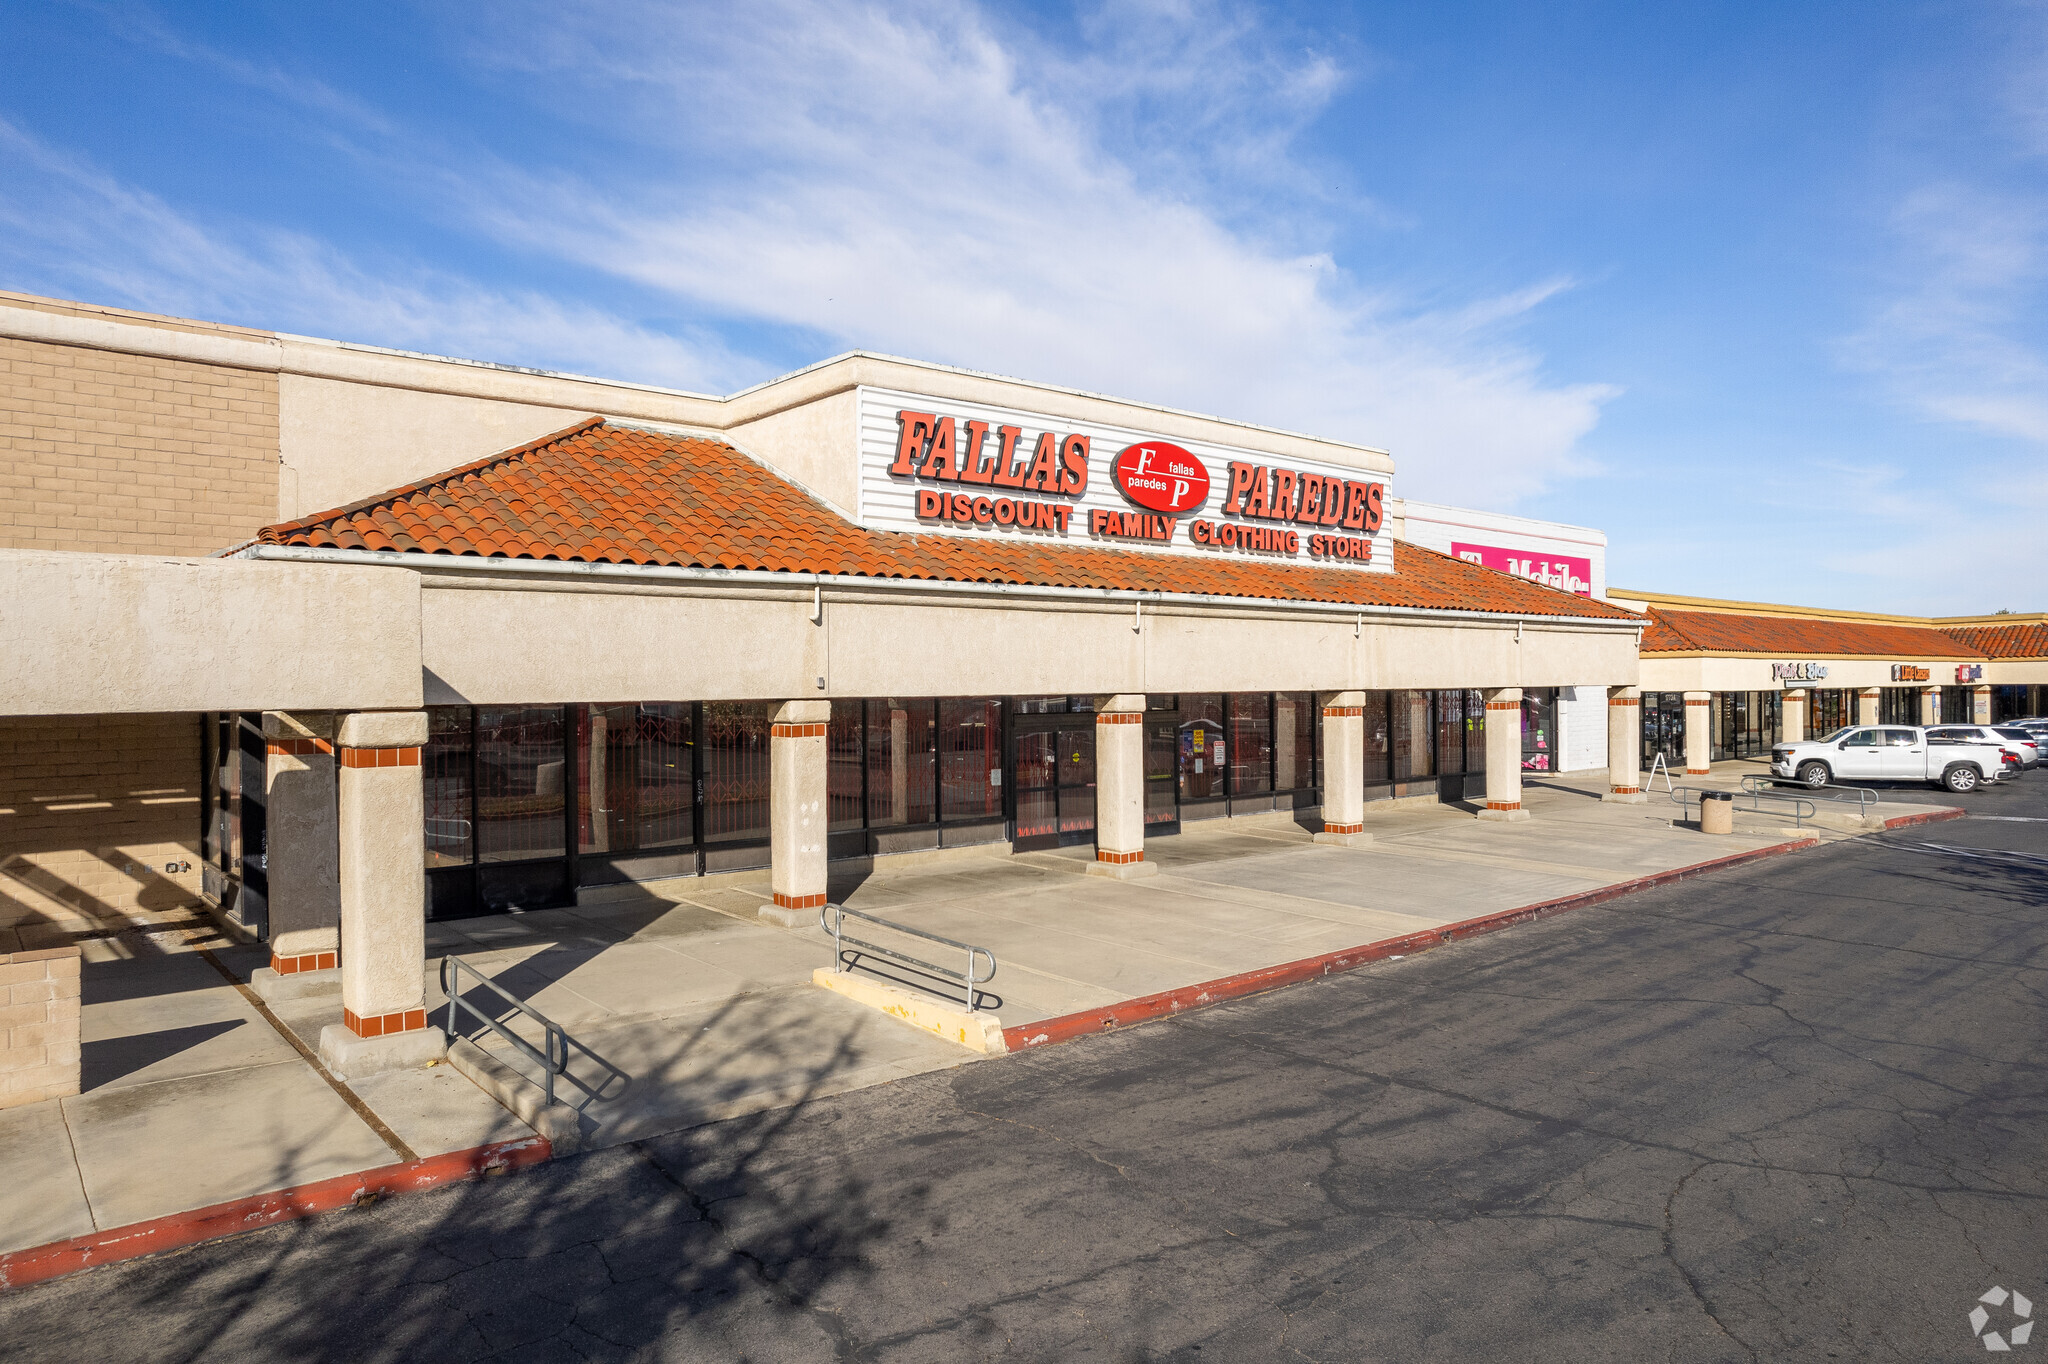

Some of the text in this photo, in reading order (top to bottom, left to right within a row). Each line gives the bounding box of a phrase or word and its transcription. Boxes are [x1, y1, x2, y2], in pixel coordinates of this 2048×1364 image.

[888, 410, 1384, 532] FALLAS PAREDES
[1137, 448, 1195, 477] F fallas
[1128, 477, 1191, 507] paredes P
[915, 490, 1373, 560] DISCOUNT FAMILY CLOTHING STORE
